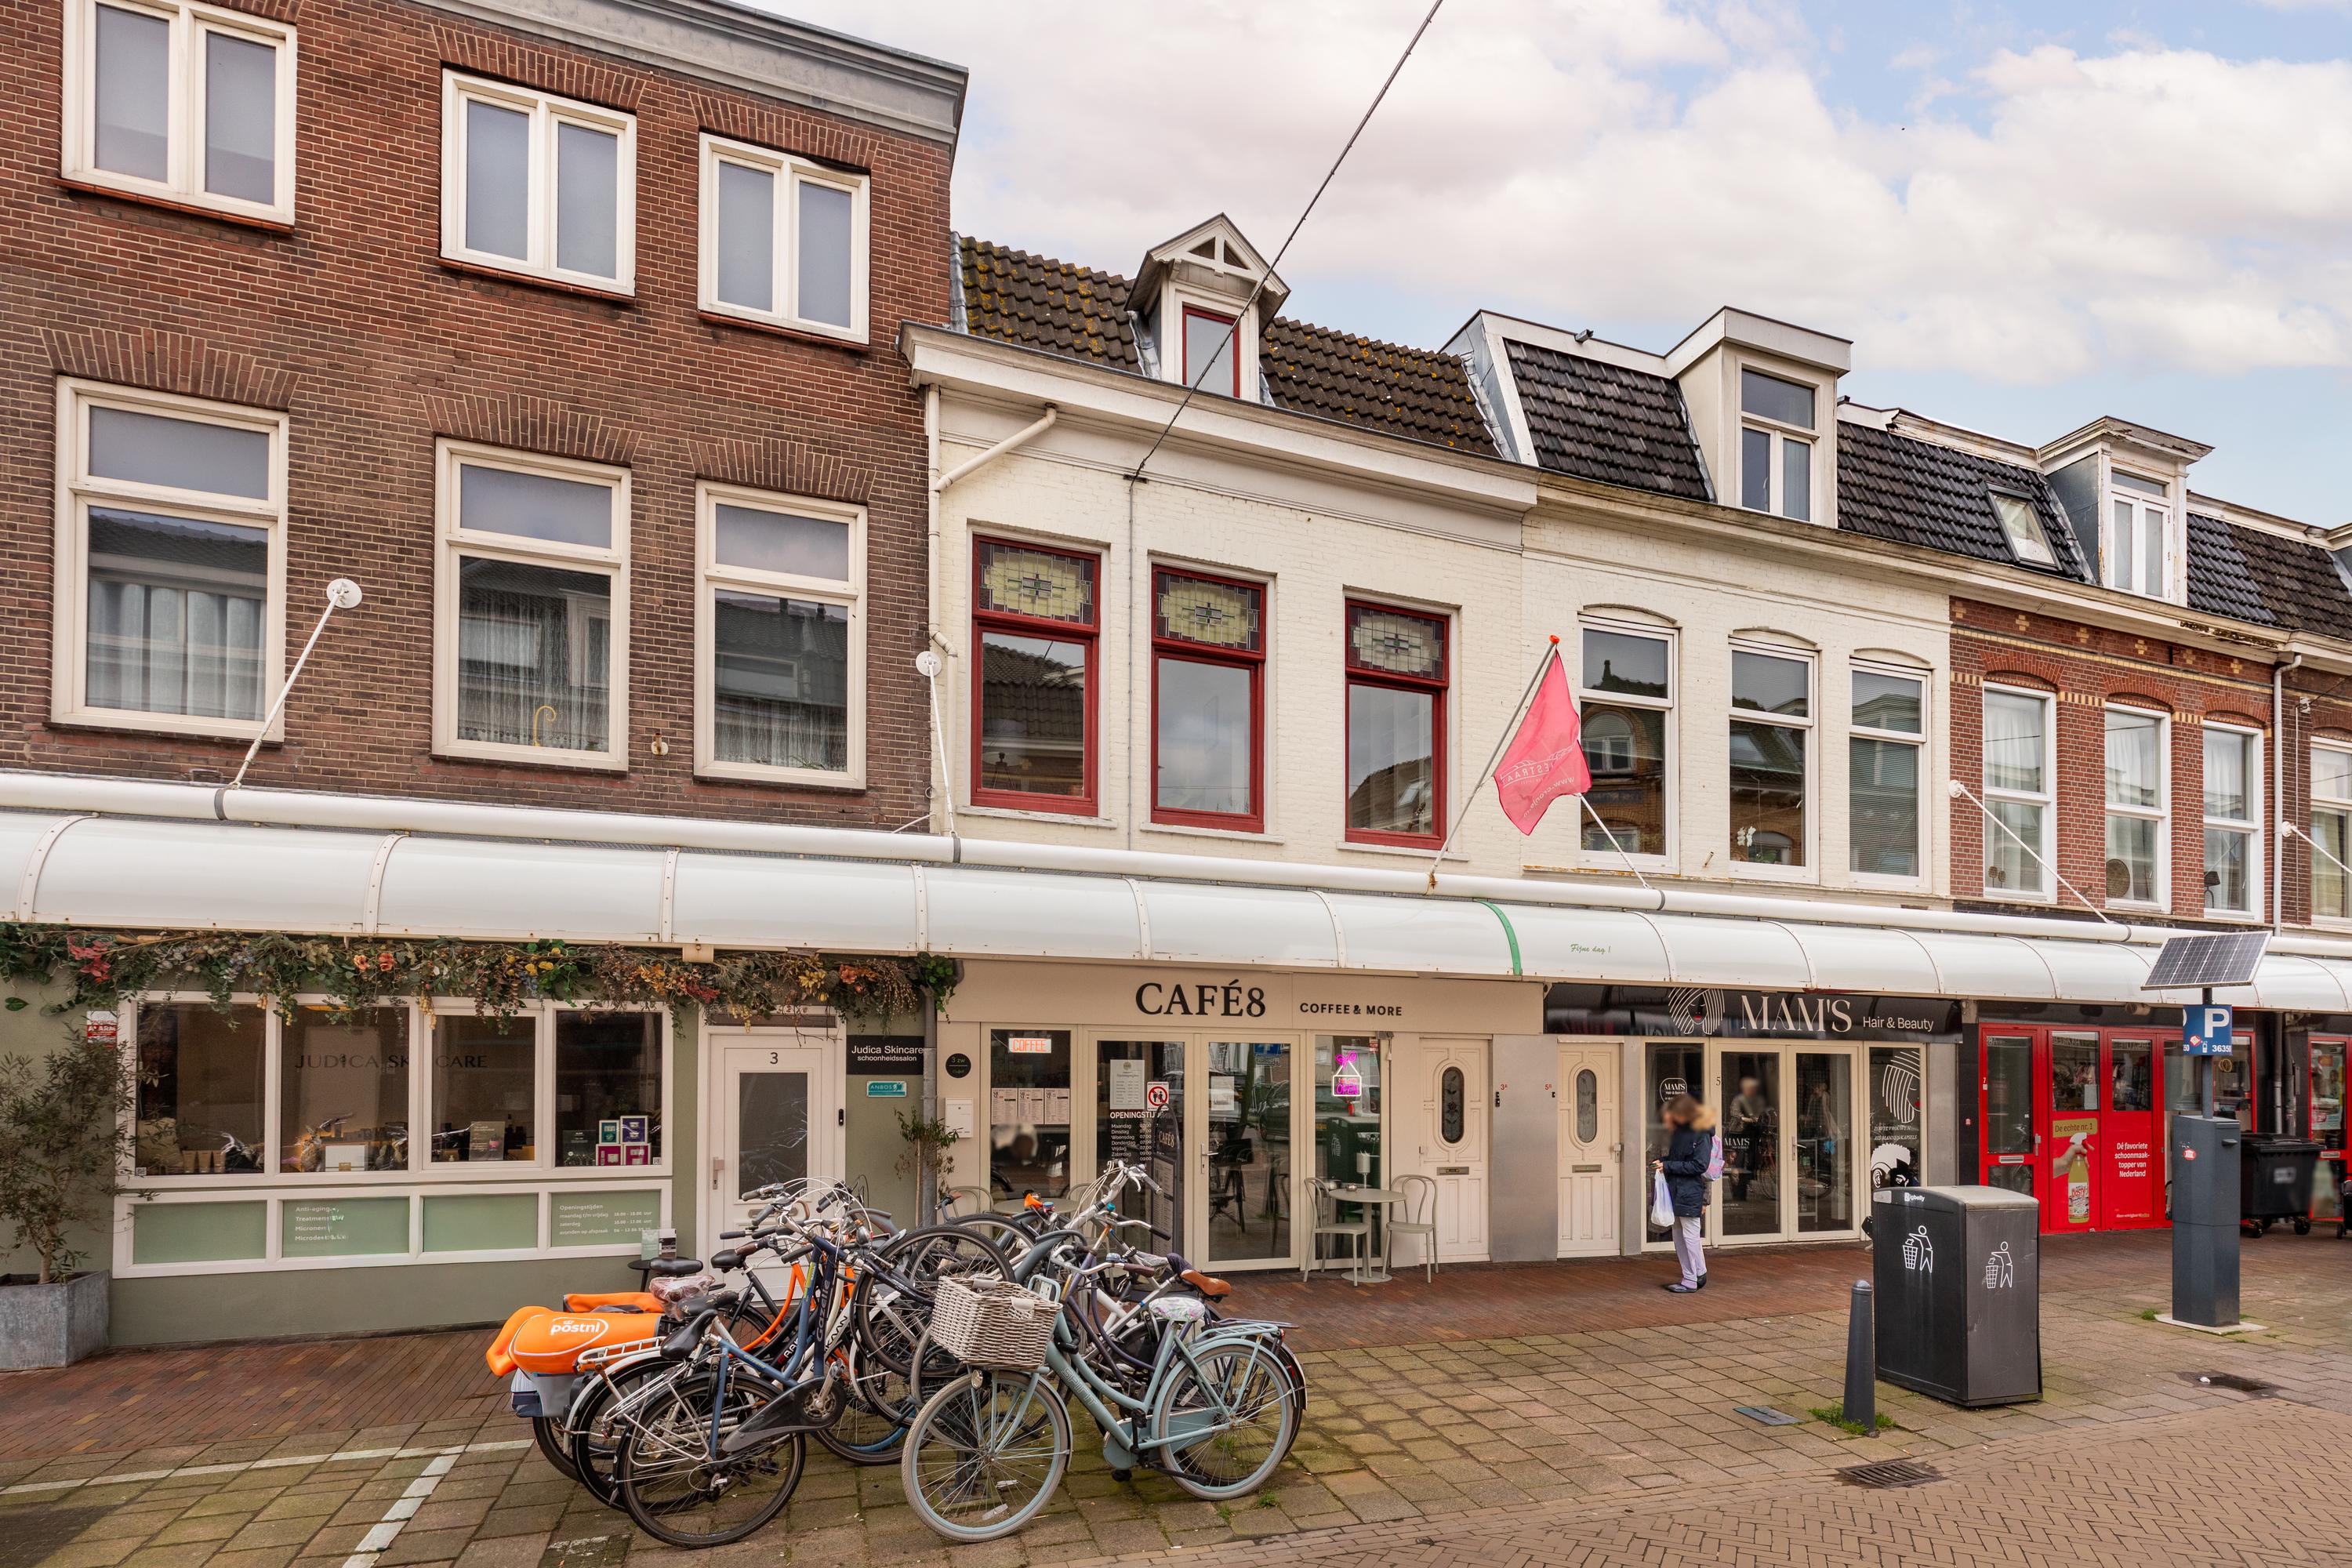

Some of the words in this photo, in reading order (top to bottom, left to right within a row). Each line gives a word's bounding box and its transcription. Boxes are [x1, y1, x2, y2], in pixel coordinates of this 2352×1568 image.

[1592, 946, 1606, 955] dag
[1135, 978, 1266, 1018] CAFÉ8
[1300, 1002, 1350, 1014] COFFEE
[1353, 1004, 1362, 1015] &
[1367, 1004, 1403, 1016] MORE
[1740, 995, 1853, 1033] MAM'S
[1862, 1016, 1885, 1029] Hair
[1886, 1018, 1895, 1029] &
[1897, 1018, 1934, 1032] Beauty
[2205, 1008, 2230, 1037] P
[851, 1045, 882, 1054] Judica
[884, 1045, 924, 1054] Skincare
[1012, 1039, 1047, 1052] COFFEE
[294, 1054, 379, 1069] JUDICA
[770, 1052, 779, 1065] 3
[1715, 1076, 1721, 1087] 5
[2063, 1123, 2081, 1132] echte
[1904, 1192, 1926, 1202] Bigbelly
[816, 1280, 831, 1342] Gazelle
[550, 1321, 601, 1336] postnl
[1060, 1367, 1098, 1406] SPIRIT
